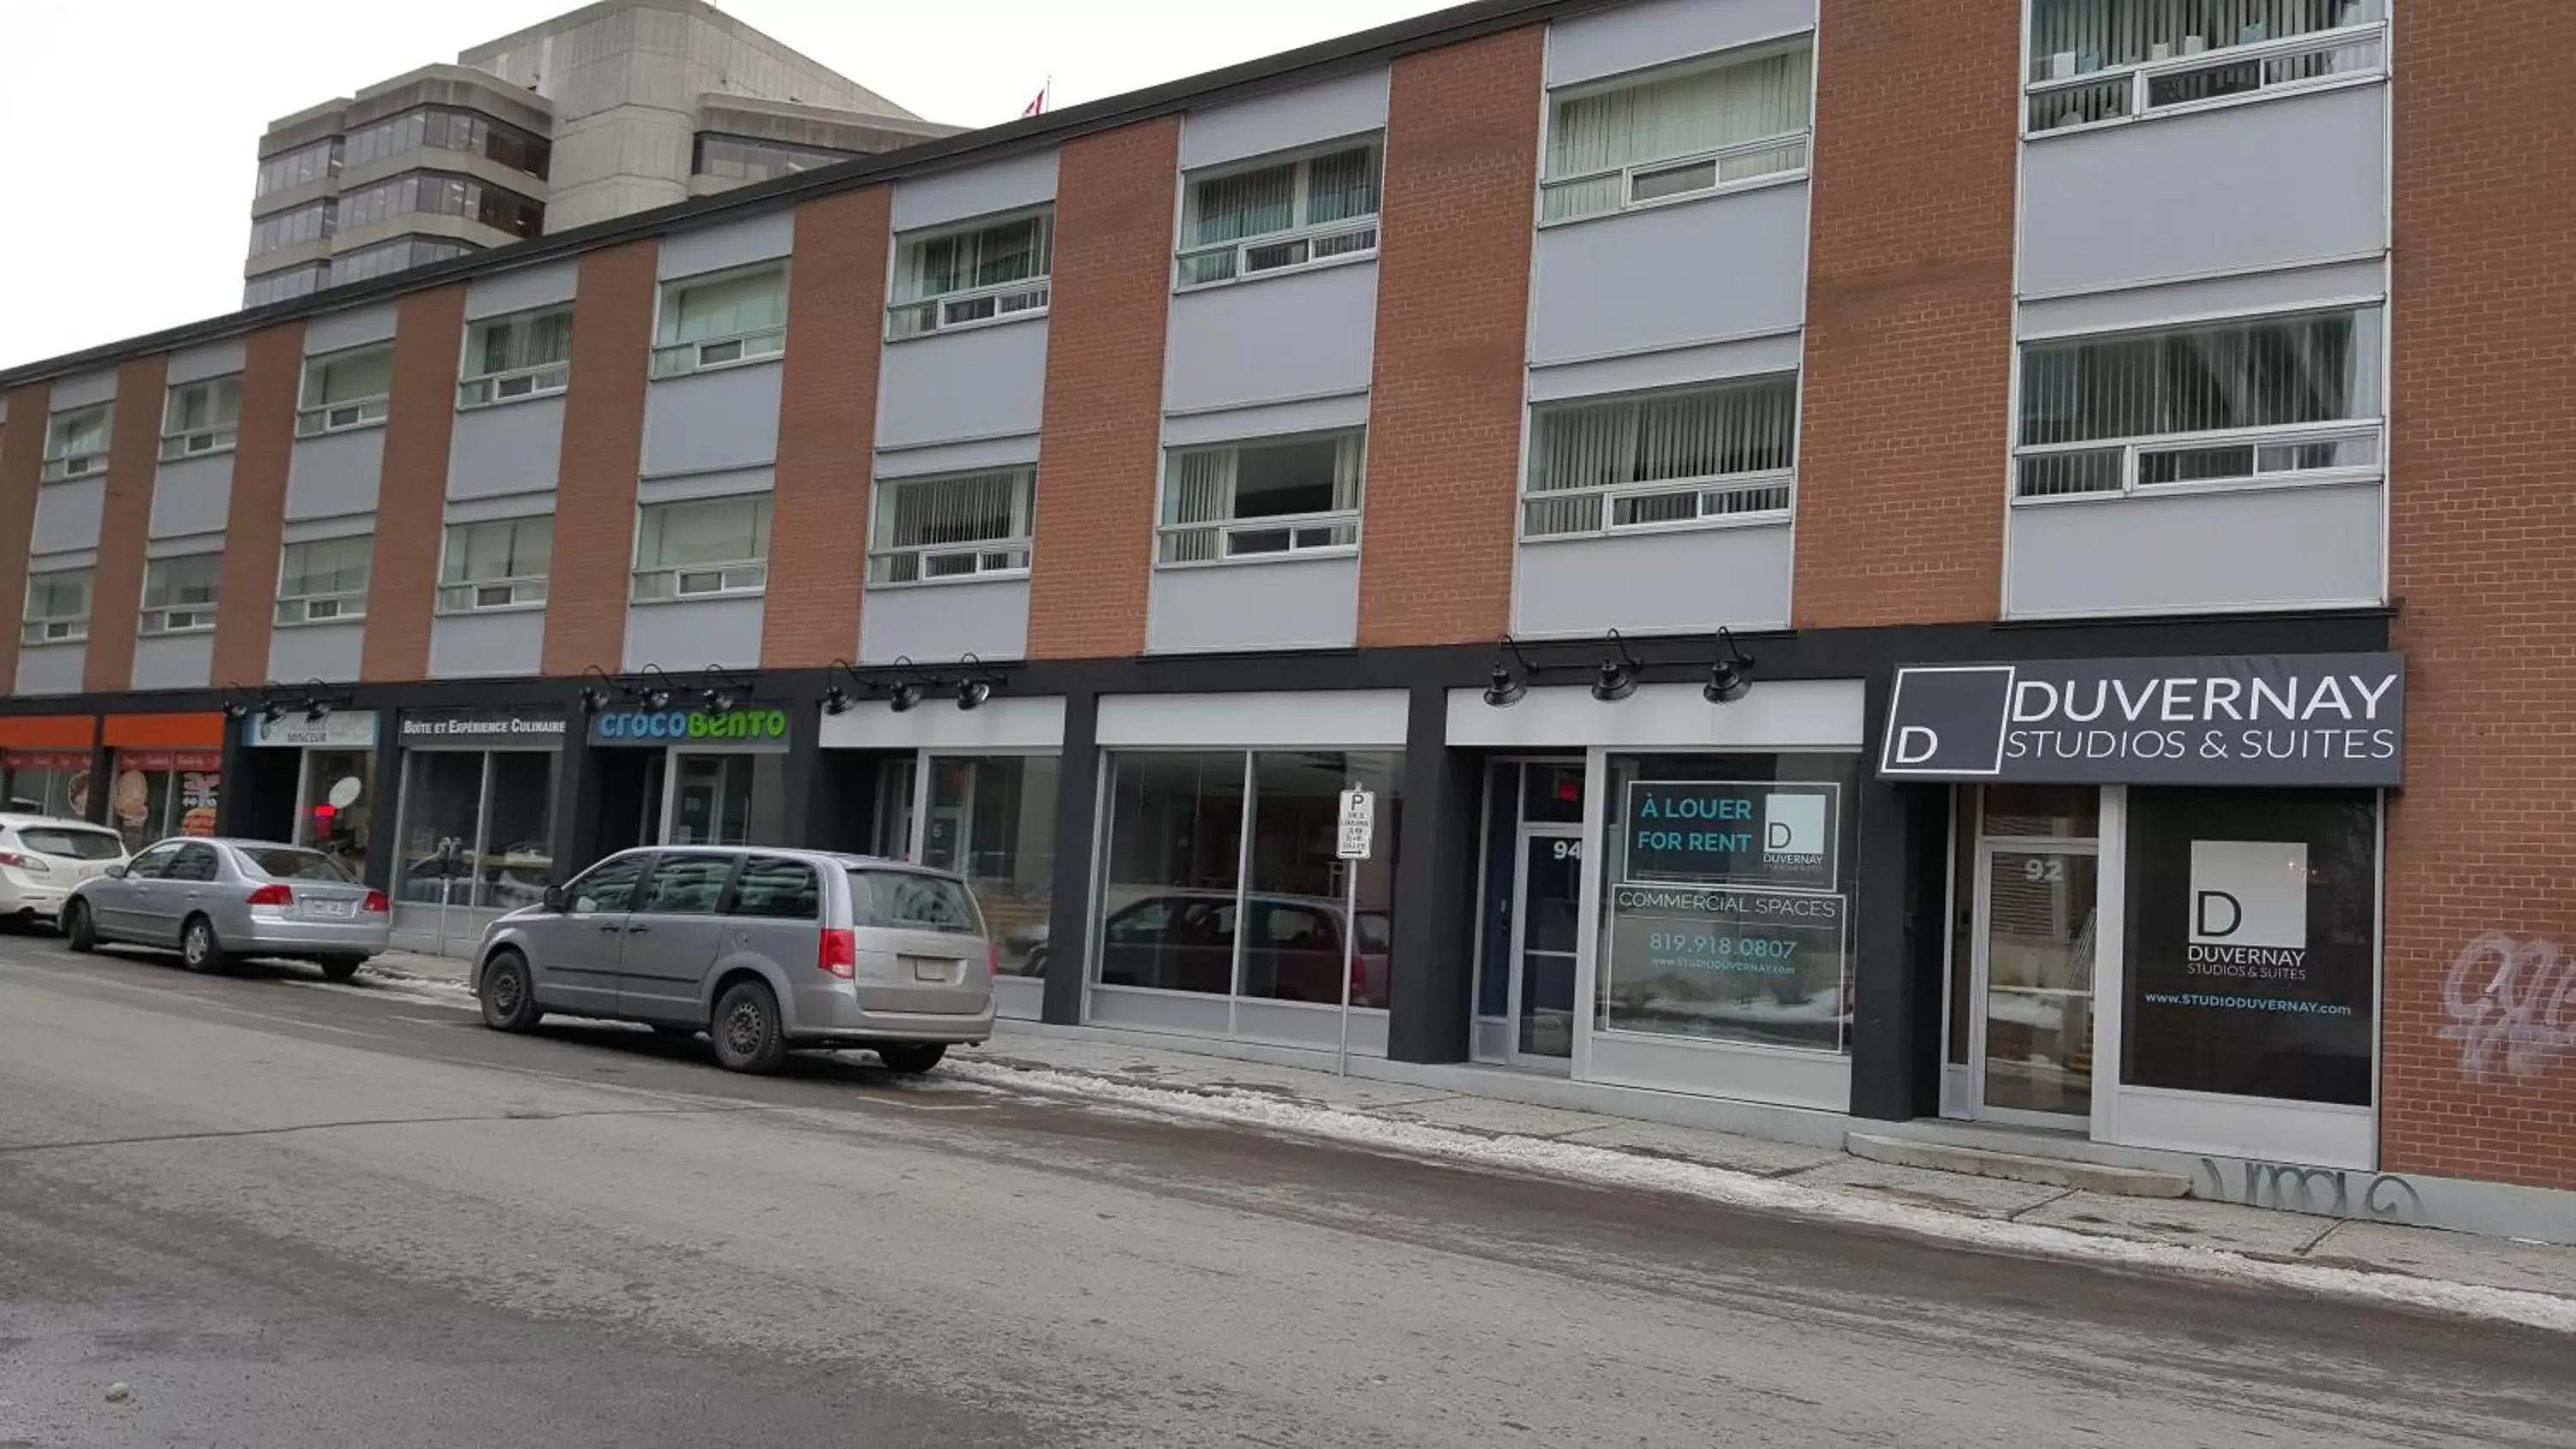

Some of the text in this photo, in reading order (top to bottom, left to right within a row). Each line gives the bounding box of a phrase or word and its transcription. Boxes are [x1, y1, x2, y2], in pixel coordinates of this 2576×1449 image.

[2012, 674, 2397, 722] DUVERNAY
[1895, 726, 1938, 764] D
[2005, 729, 2395, 760] STUDIOS & SUITES
[1351, 794, 1364, 810] P
[1641, 792, 1753, 821] À LOUER
[1637, 830, 1753, 852] FOR RENT
[1769, 822, 1792, 849] D
[1553, 840, 1581, 859] 94
[1763, 852, 1823, 864] DUVERNAY
[2026, 859, 2063, 881] 92
[1619, 892, 1836, 919] COMMERCIAL SPACES
[2197, 890, 2242, 937] D
[1649, 932, 1798, 960] 819.918.0807
[2188, 945, 2306, 967] DUVERNAY
[2187, 963, 2306, 980] STUDIOS & SUITES
[2145, 992, 2352, 1016] www.STUDIODUVERNAY.com
